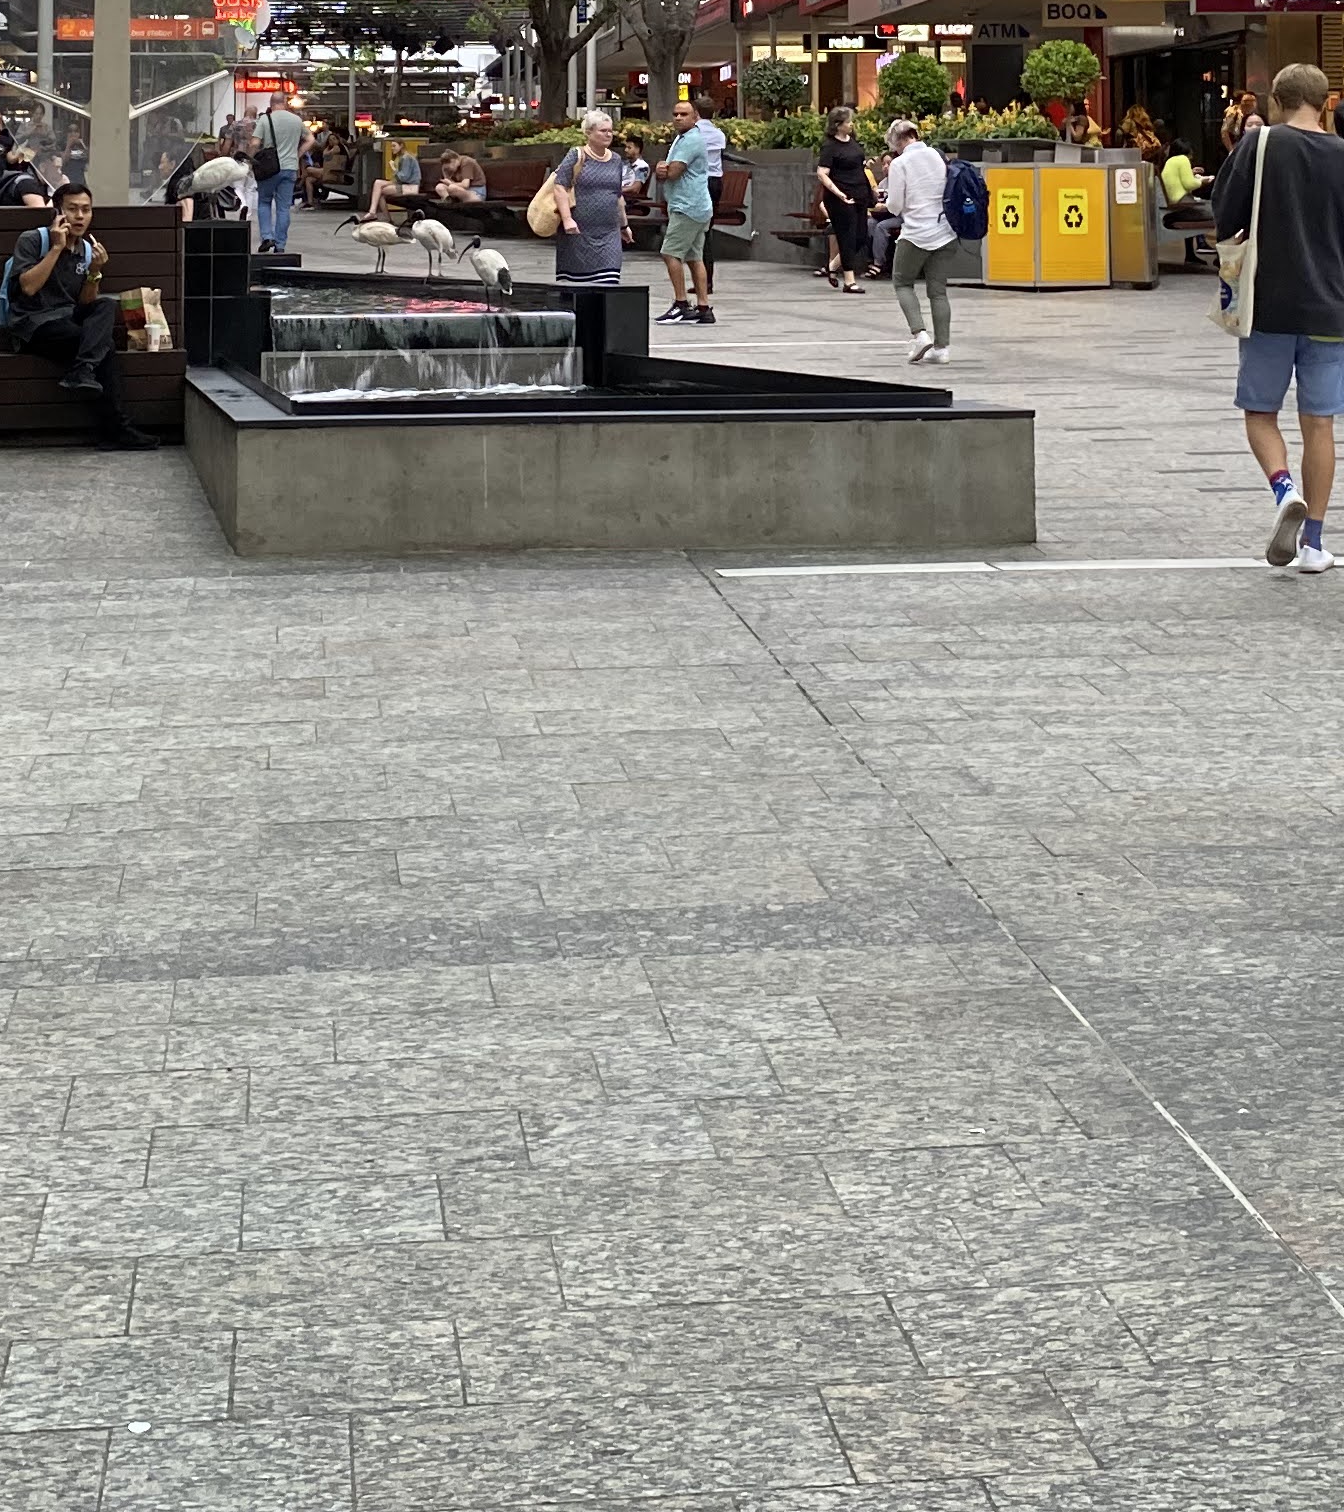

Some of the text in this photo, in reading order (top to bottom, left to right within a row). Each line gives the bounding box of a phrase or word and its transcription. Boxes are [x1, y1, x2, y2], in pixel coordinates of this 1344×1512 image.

[1047, 3, 1091, 20] BOQ
[183, 24, 192, 37] 2
[977, 23, 1017, 38] ATM
[828, 35, 864, 49] rebel
